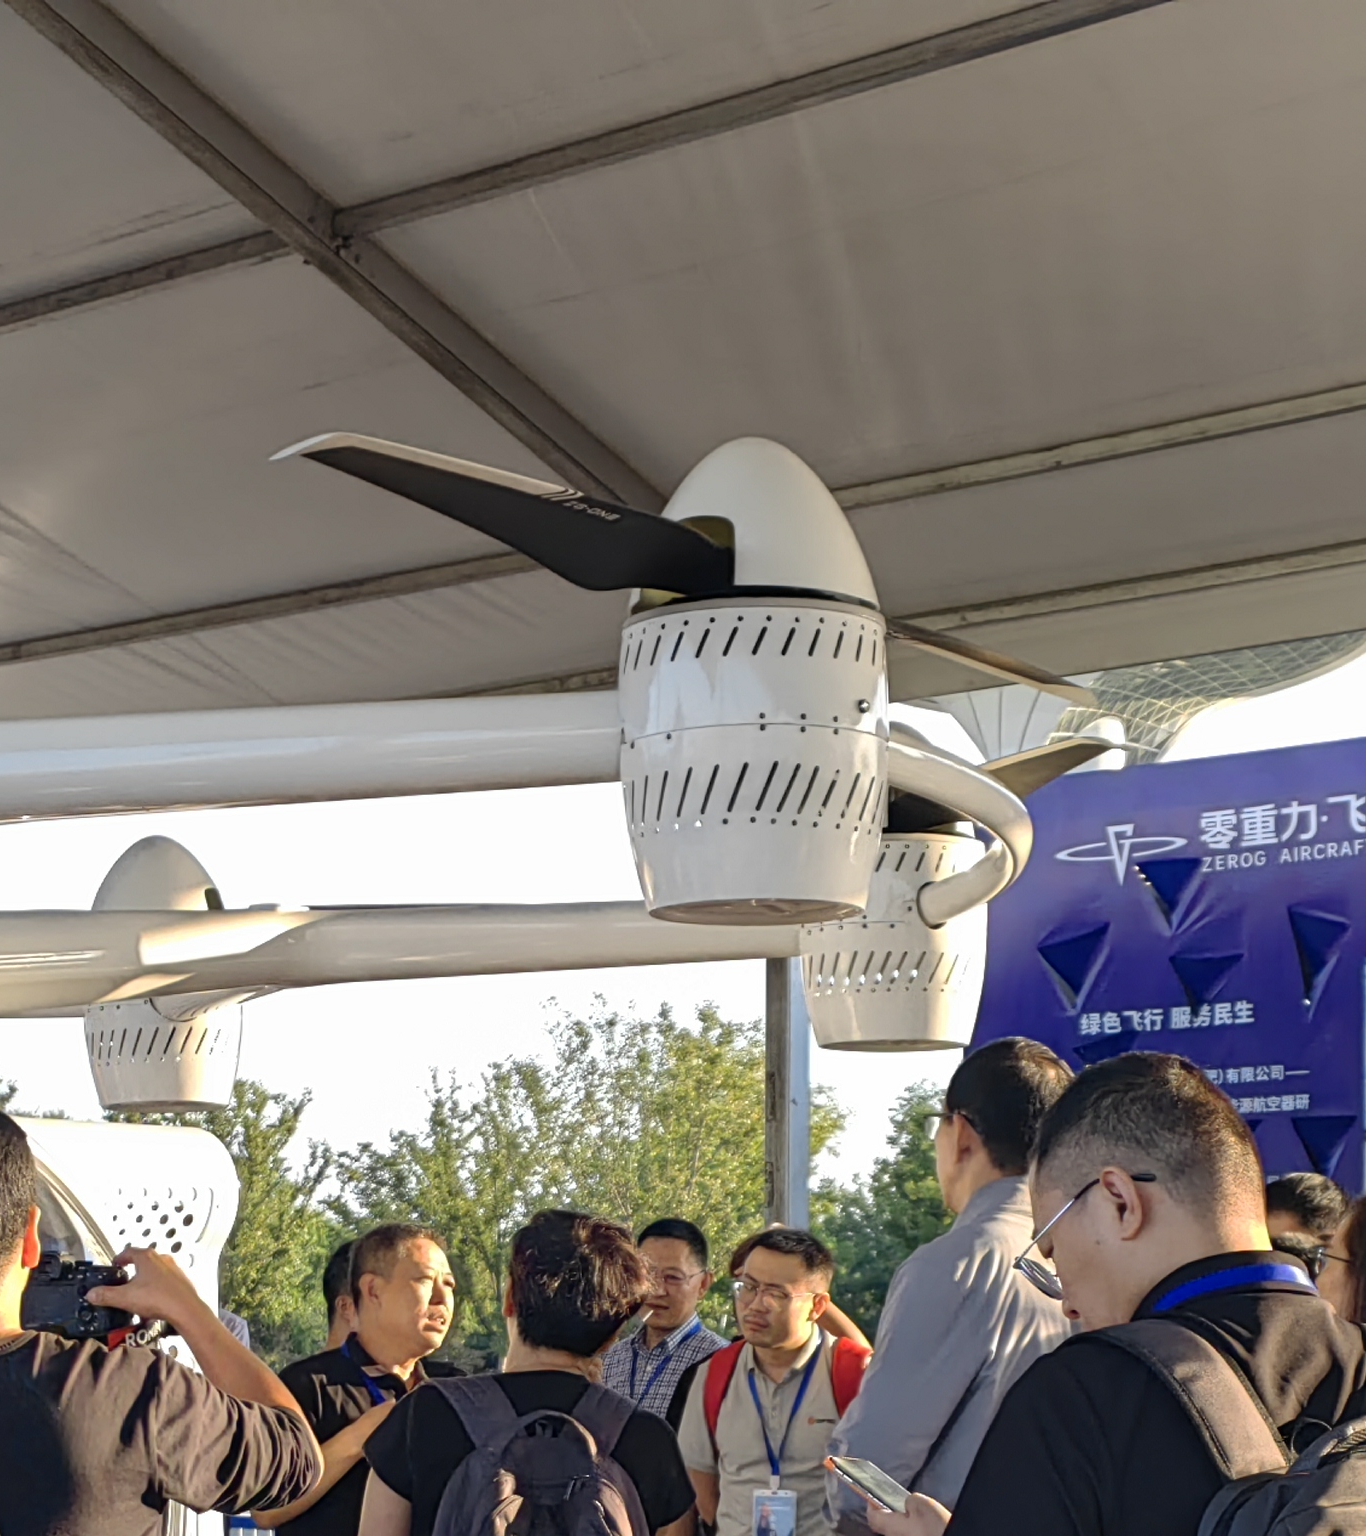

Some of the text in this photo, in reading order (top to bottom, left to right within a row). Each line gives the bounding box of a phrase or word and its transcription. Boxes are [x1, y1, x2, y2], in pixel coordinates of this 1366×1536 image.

[1202, 850, 1267, 872] ZEROG
[1080, 1000, 1255, 1036] 绿色飞行 服务民生
